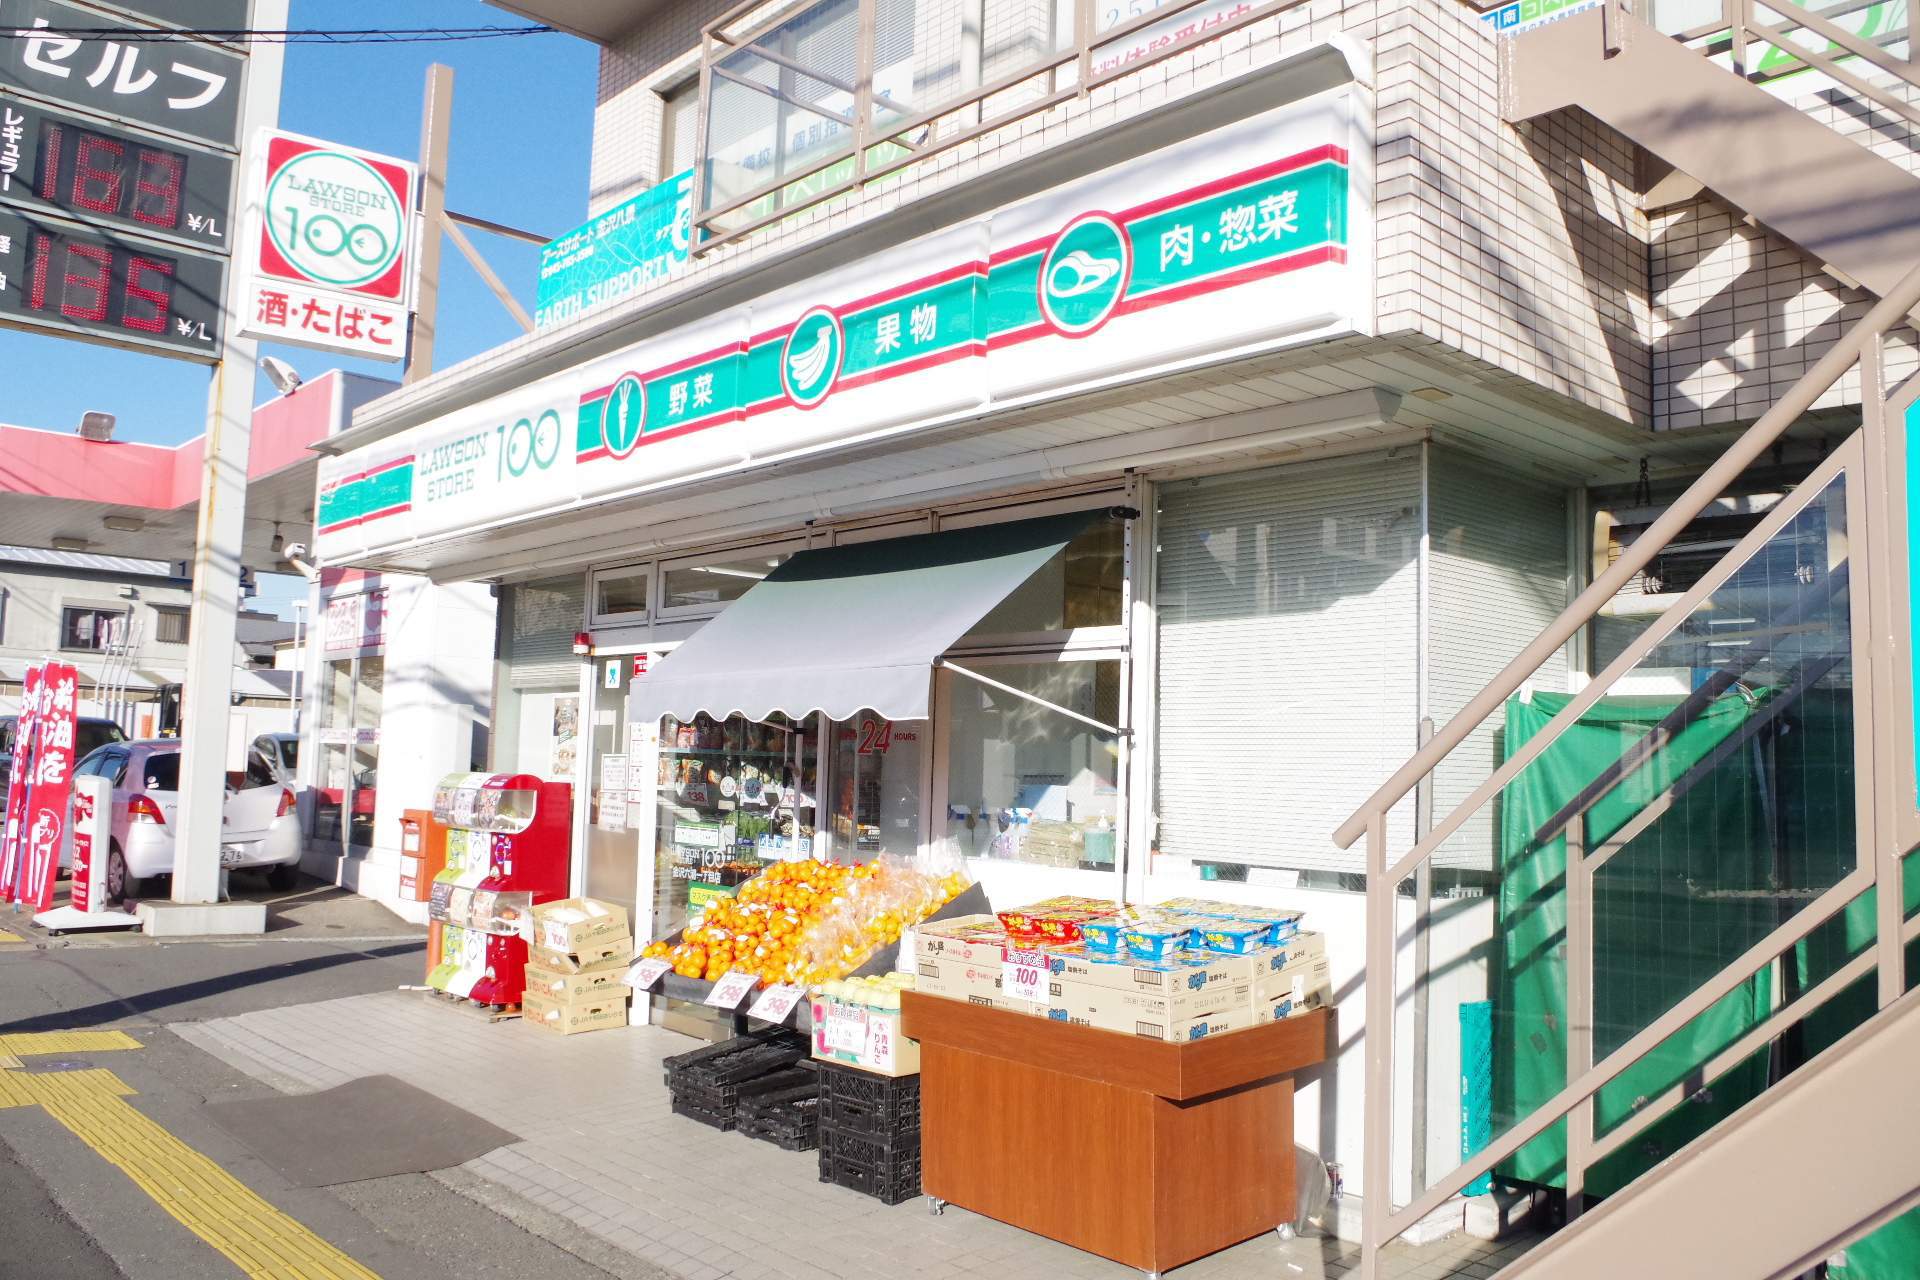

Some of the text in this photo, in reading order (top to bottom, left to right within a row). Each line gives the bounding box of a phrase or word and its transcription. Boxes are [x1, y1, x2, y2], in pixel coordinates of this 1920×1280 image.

[16, 17, 227, 110] セルフ
[0, 107, 24, 192] レギュラー
[287, 172, 388, 211] LAWSON
[308, 195, 366, 218] STORE
[284, 207, 388, 266] 100
[1159, 189, 1299, 272] 肉・惣菜
[31, 233, 173, 335] 135
[535, 291, 583, 330] EARTH
[587, 254, 667, 306] SUPPORT
[257, 289, 394, 345] 酒・たばこ
[874, 302, 938, 356] 果物
[667, 372, 713, 417] 野菜
[419, 431, 490, 476] LAWSON
[496, 408, 561, 484] 100
[426, 468, 475, 502] STORE
[178, 561, 187, 577] 1
[240, 566, 249, 582] 2
[857, 719, 892, 755] 24
[895, 732, 917, 741] HOURS
[701, 848, 725, 868] 100
[1016, 967, 1038, 986] 100
[873, 1032, 881, 1065] りんご
